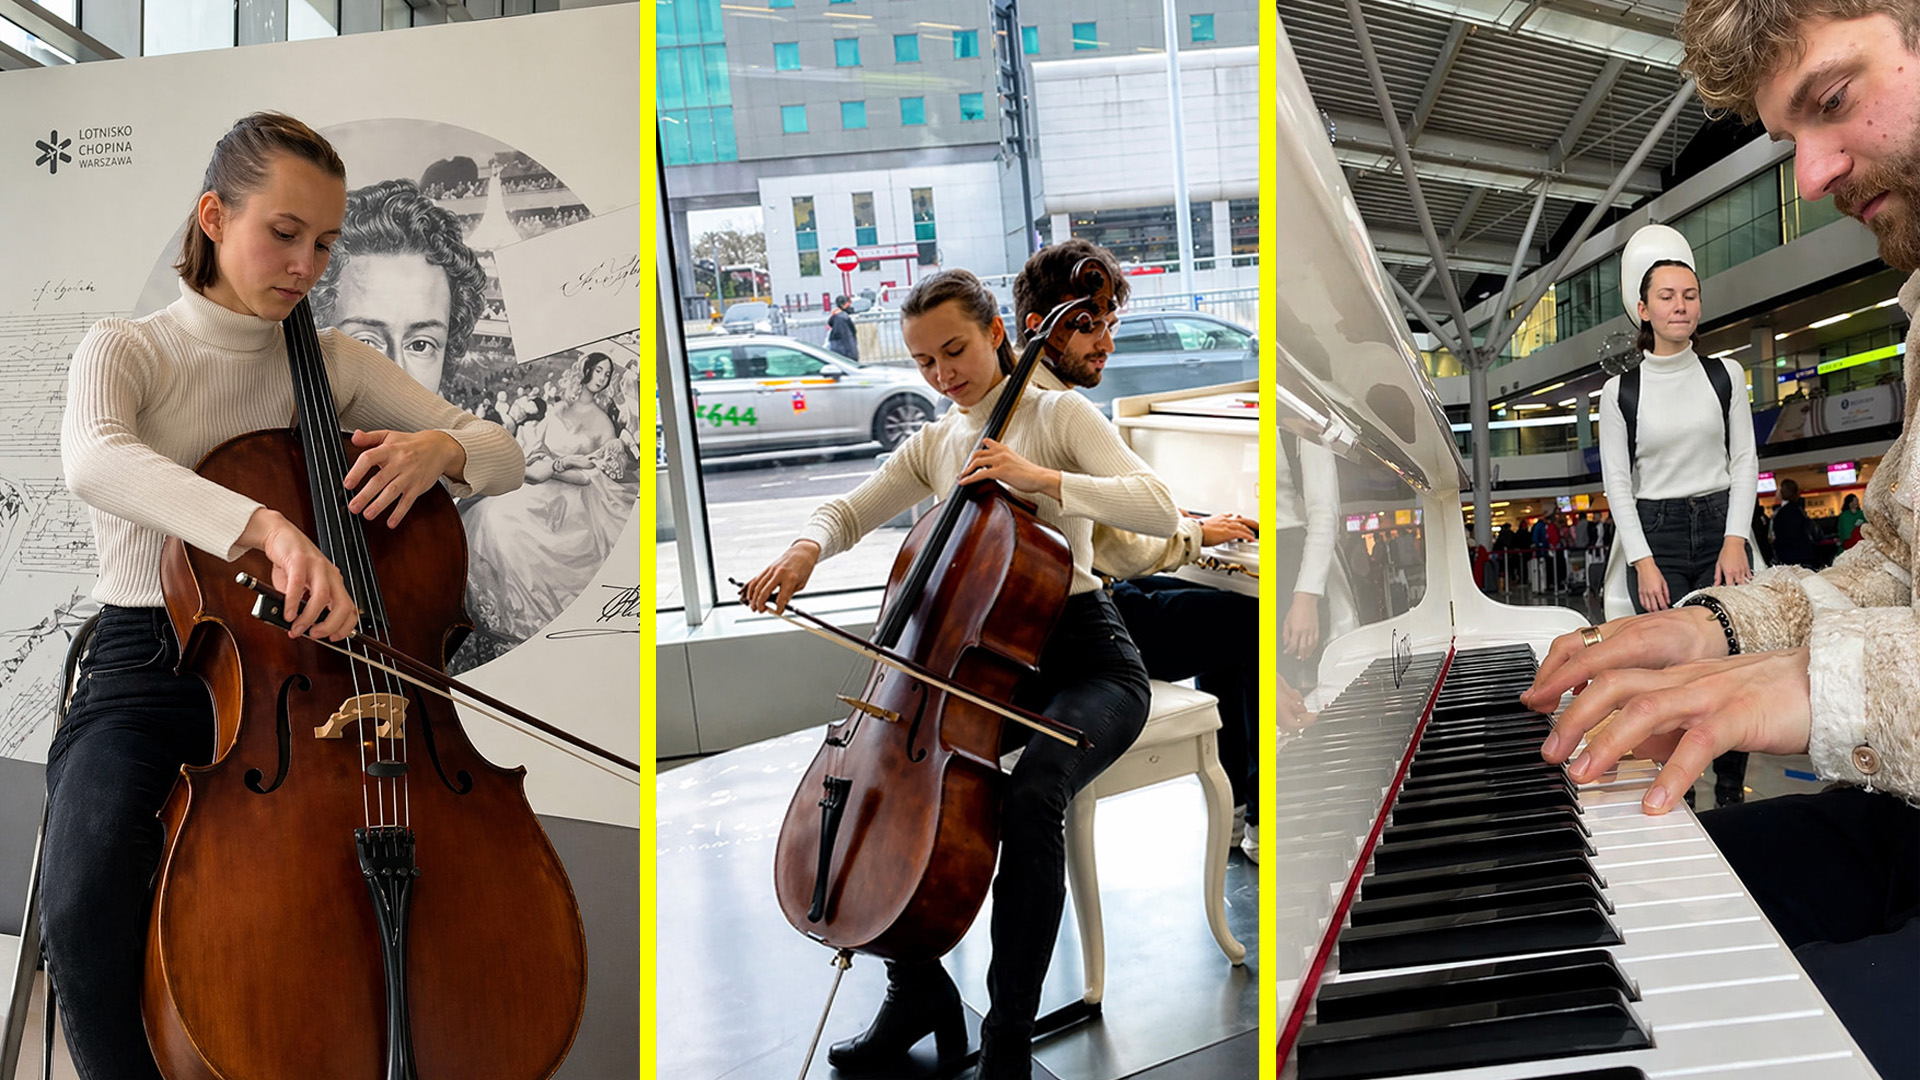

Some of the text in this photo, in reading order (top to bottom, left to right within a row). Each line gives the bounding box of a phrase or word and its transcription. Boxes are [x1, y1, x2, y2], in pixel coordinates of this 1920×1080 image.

[79, 125, 133, 140] LOTNISKO
[78, 141, 133, 156] CHOPINA
[79, 156, 133, 168] WARSZAWA
